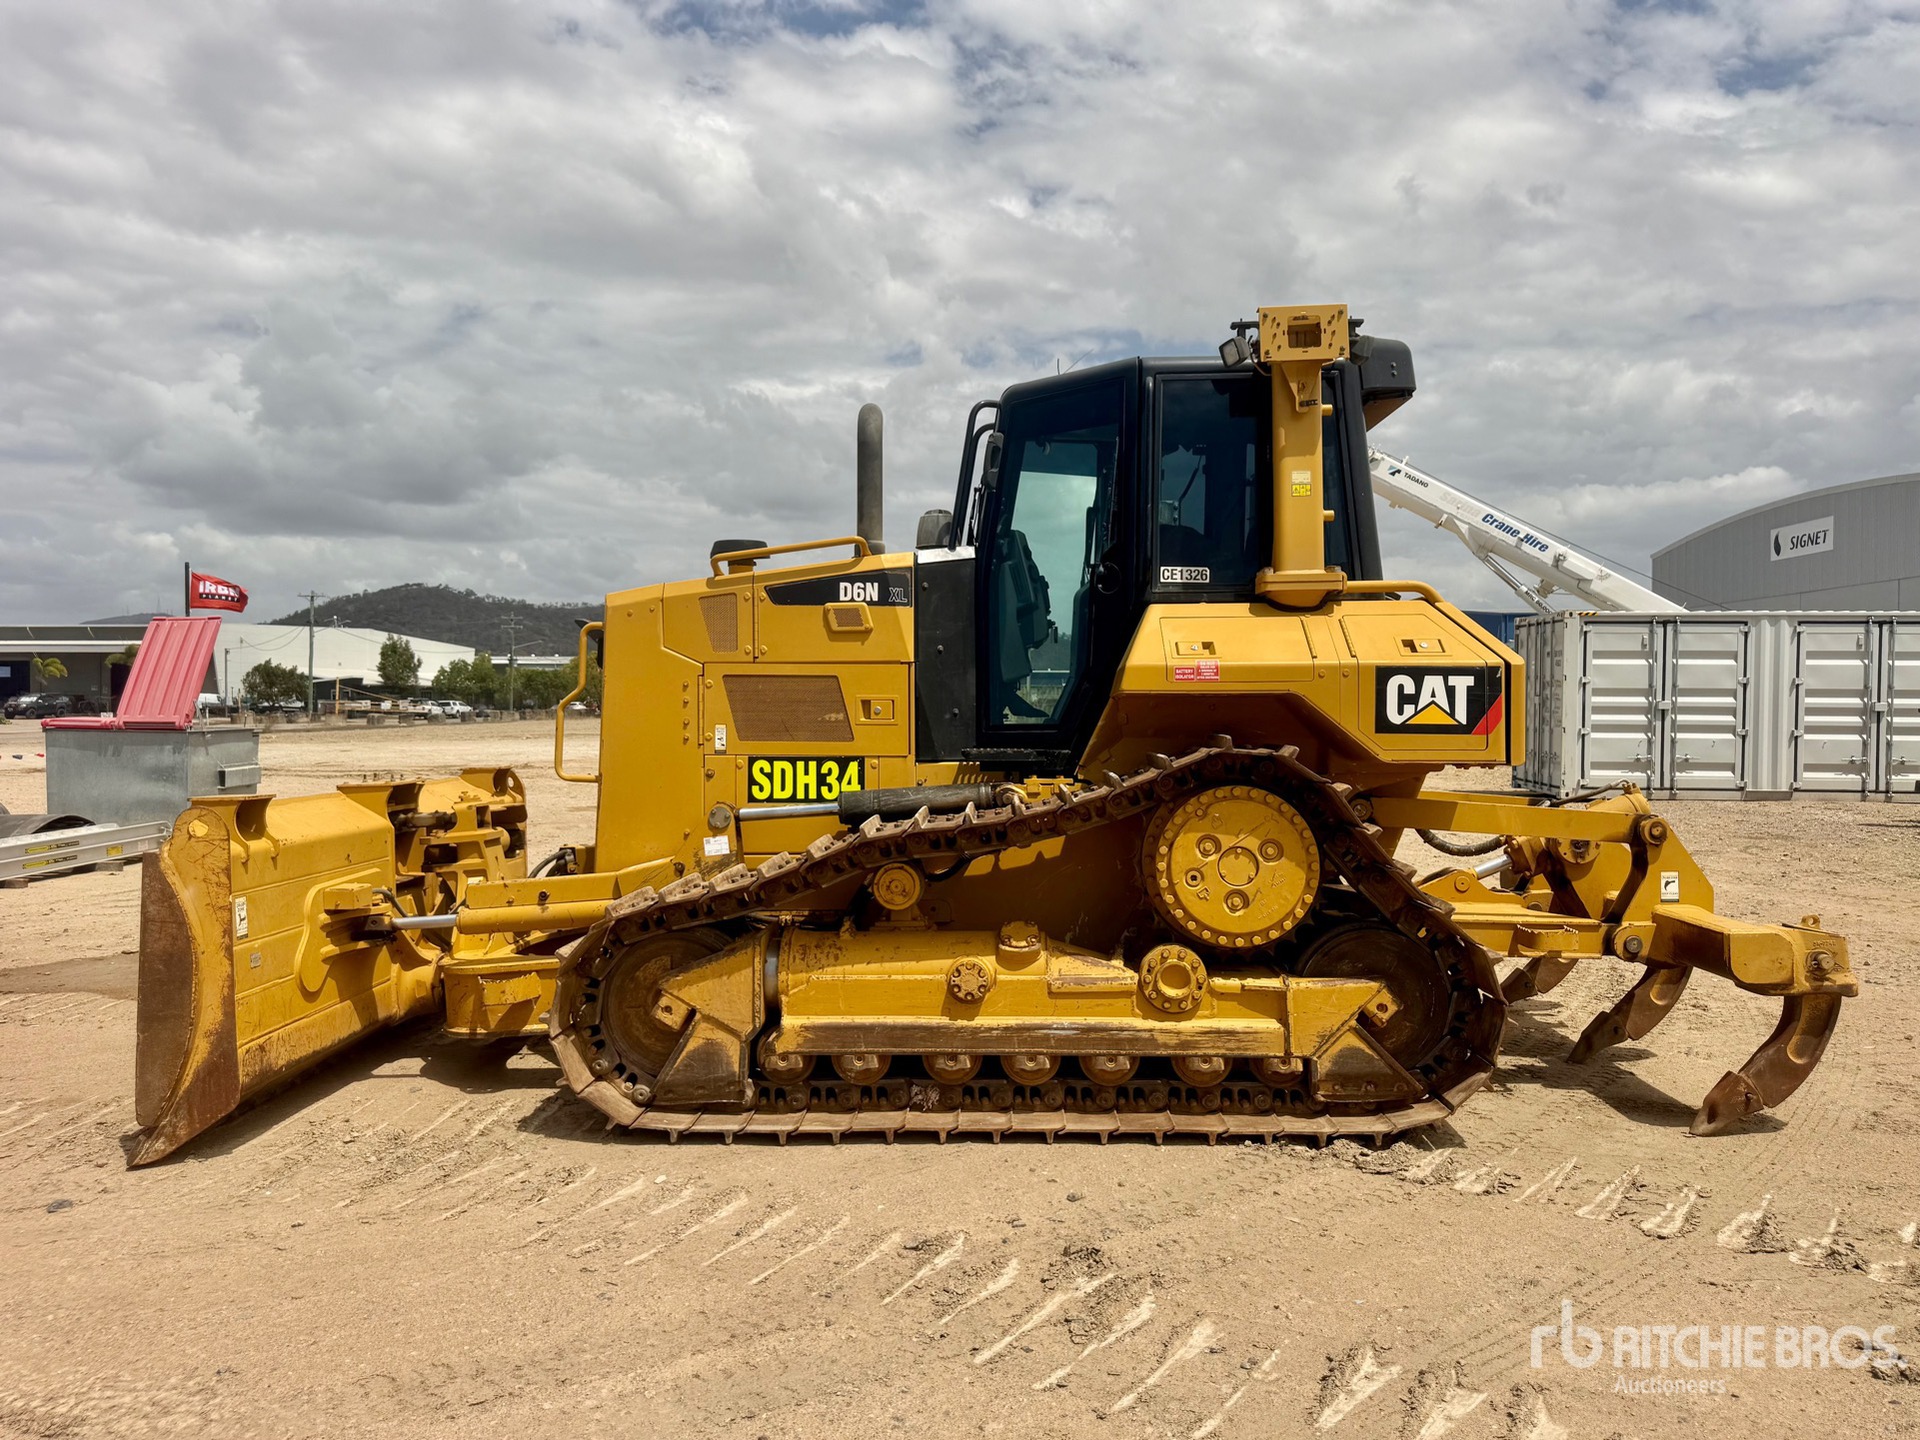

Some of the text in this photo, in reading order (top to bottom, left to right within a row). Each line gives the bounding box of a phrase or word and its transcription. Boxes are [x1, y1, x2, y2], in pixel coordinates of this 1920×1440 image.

[1404, 472, 1429, 488] TADANO
[1481, 513, 1520, 538] Crane
[1522, 533, 1549, 552] Hire
[1790, 529, 1829, 550] SIGNET
[1162, 568, 1208, 581] CE1326
[839, 582, 908, 602] D6N XL
[1386, 674, 1475, 725] CAT
[751, 759, 861, 800] SDH34
